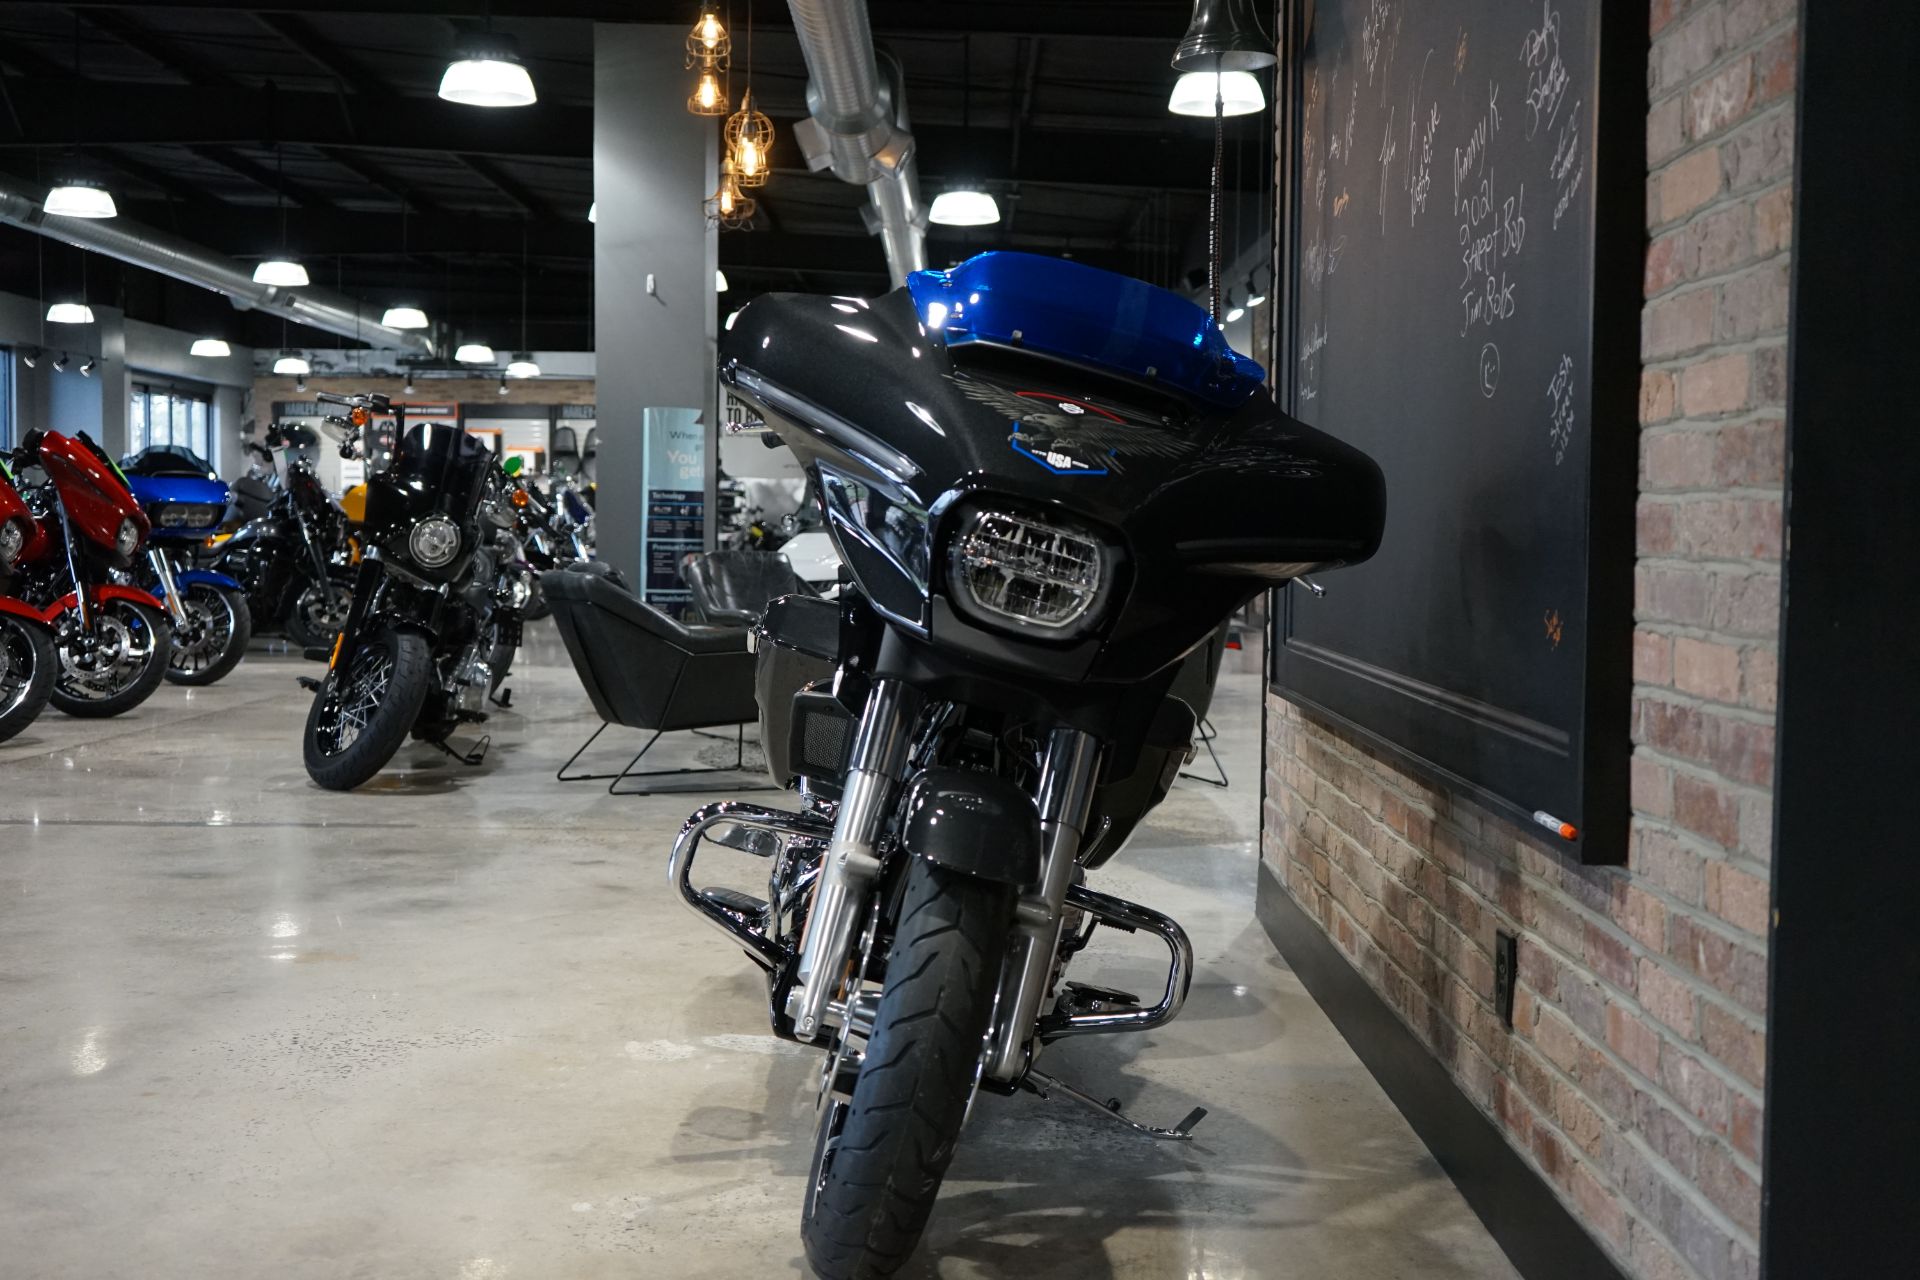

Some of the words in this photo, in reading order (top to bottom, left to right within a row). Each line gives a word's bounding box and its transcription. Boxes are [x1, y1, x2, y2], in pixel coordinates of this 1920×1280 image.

[1459, 167, 1494, 246] 2021
[667, 450, 698, 465] You
[1046, 451, 1071, 468] USA
